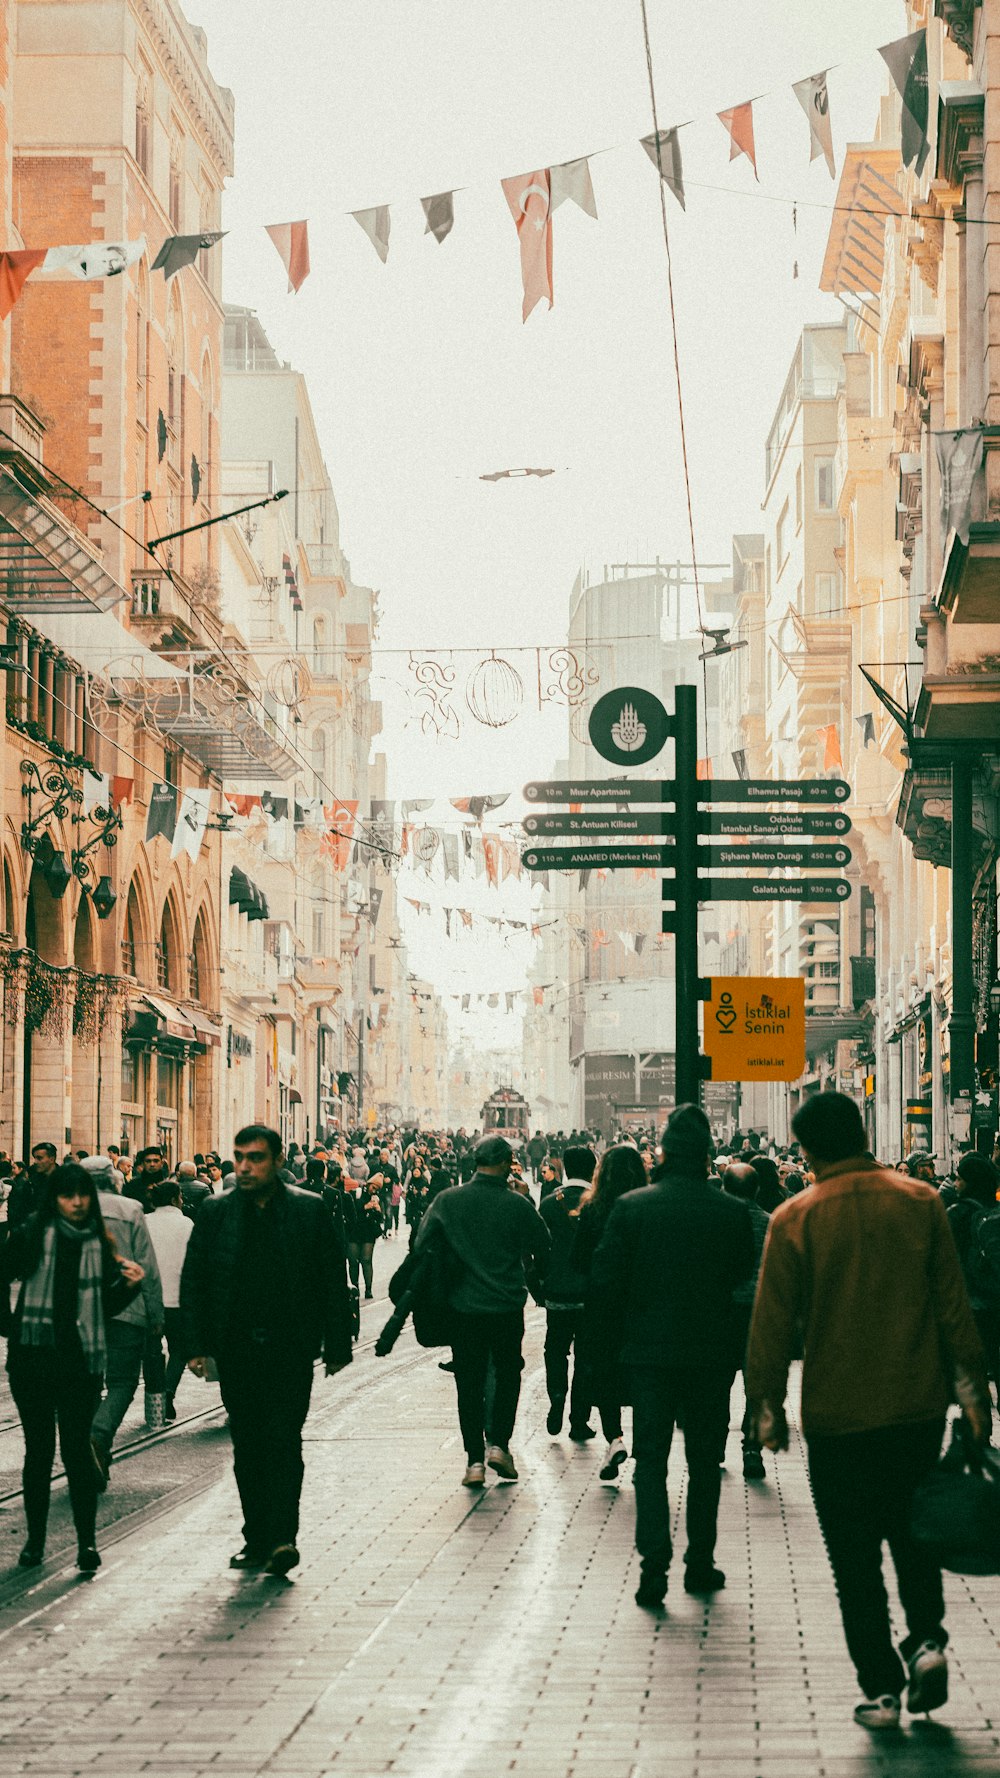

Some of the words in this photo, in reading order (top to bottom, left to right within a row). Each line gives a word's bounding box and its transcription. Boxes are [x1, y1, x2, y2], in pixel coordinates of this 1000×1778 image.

[590, 789, 631, 797] Apartmanı
[781, 788, 803, 797] Pasajı
[721, 824, 751, 833] İstanbul
[754, 825, 778, 834] Sanayi
[720, 852, 750, 862] Şişhane
[777, 852, 803, 862] Durağı
[745, 1022, 784, 1034] Senin
